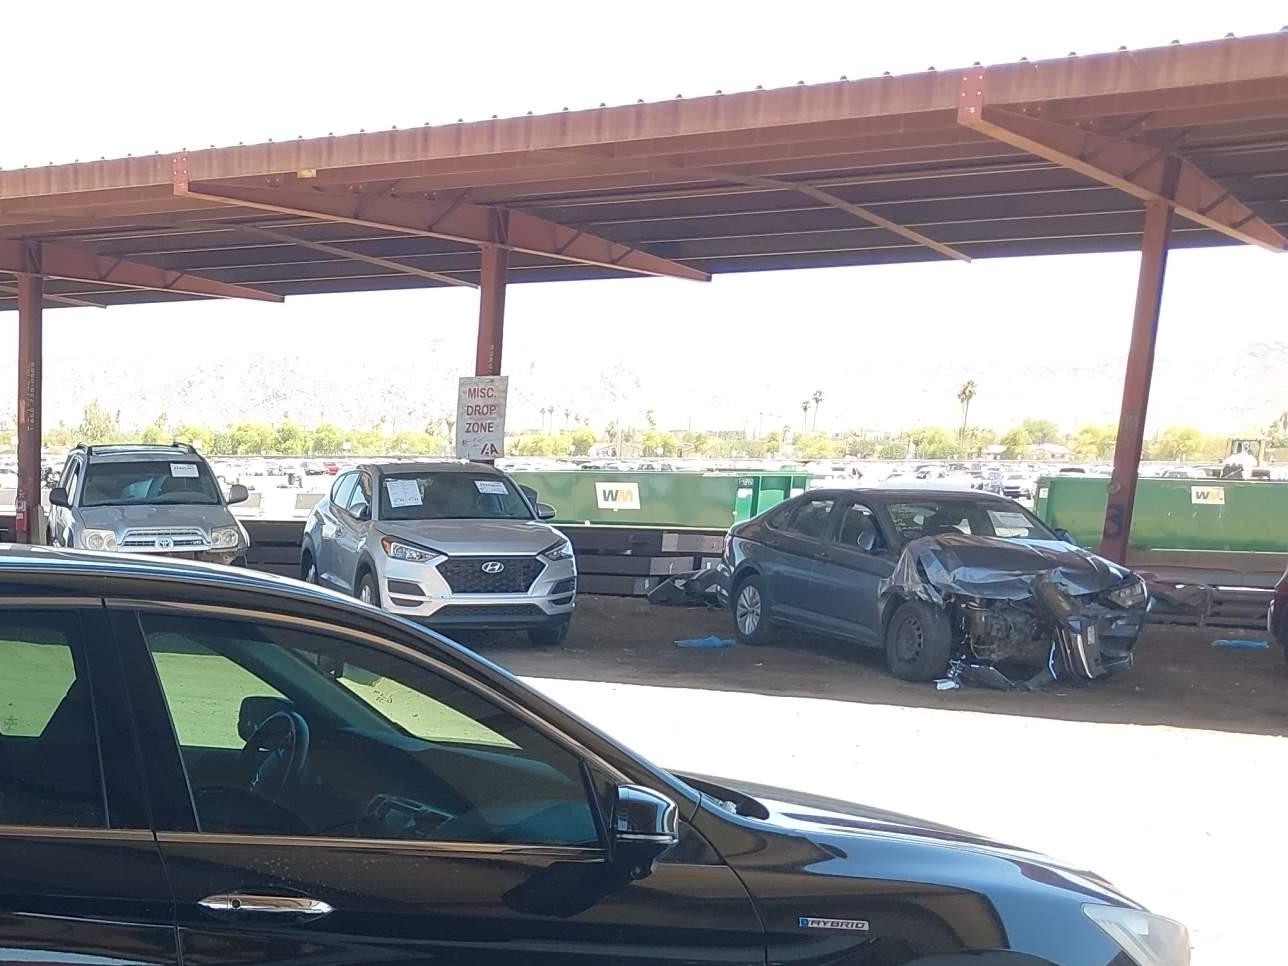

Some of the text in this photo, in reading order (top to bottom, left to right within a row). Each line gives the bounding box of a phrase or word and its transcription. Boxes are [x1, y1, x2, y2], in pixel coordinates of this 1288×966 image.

[467, 387, 497, 400] MISC.
[466, 404, 497, 416] DROP
[465, 421, 495, 434] ZONE
[602, 489, 633, 502] WM
[810, 919, 866, 929] HYBRID
